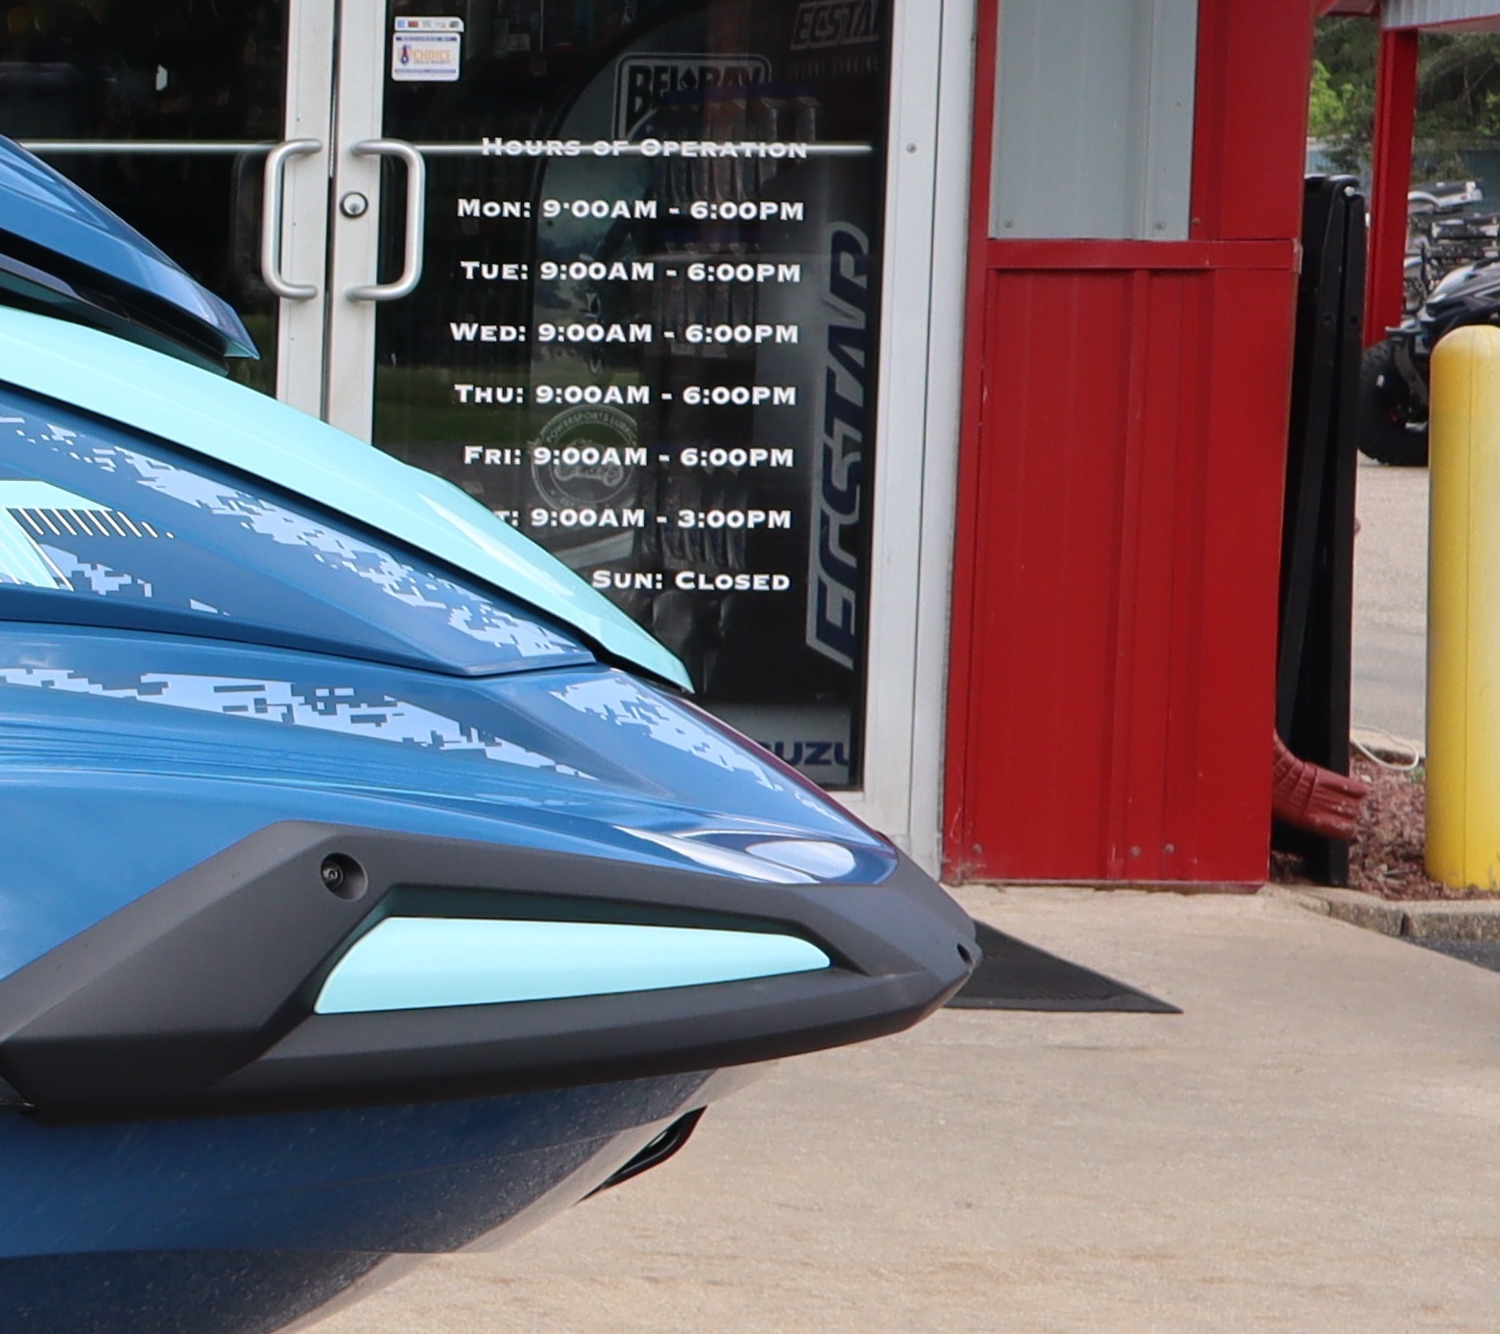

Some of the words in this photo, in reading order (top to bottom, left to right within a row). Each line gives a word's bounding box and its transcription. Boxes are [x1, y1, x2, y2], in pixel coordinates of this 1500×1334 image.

[457, 199, 532, 218] MON:
[690, 201, 805, 220] 6:00PM
[460, 260, 529, 280] TUE:
[540, 261, 655, 281] 9:00AM
[687, 263, 801, 282] 6:00PM
[450, 322, 526, 342] WED:
[537, 323, 652, 343] 9:00AM
[685, 324, 799, 343] 6:00PM
[454, 383, 524, 404] THU:
[535, 384, 650, 405] 9:00AM
[682, 386, 796, 405] 6:00PM
[463, 445, 521, 465] FRI:
[533, 446, 648, 466] 9:00AM
[680, 447, 794, 467] 6:00PM
[530, 508, 645, 528] 9:00AM
[677, 510, 792, 529] 3:00PM
[592, 570, 663, 589] SUN:
[675, 571, 791, 591] CLOSED
